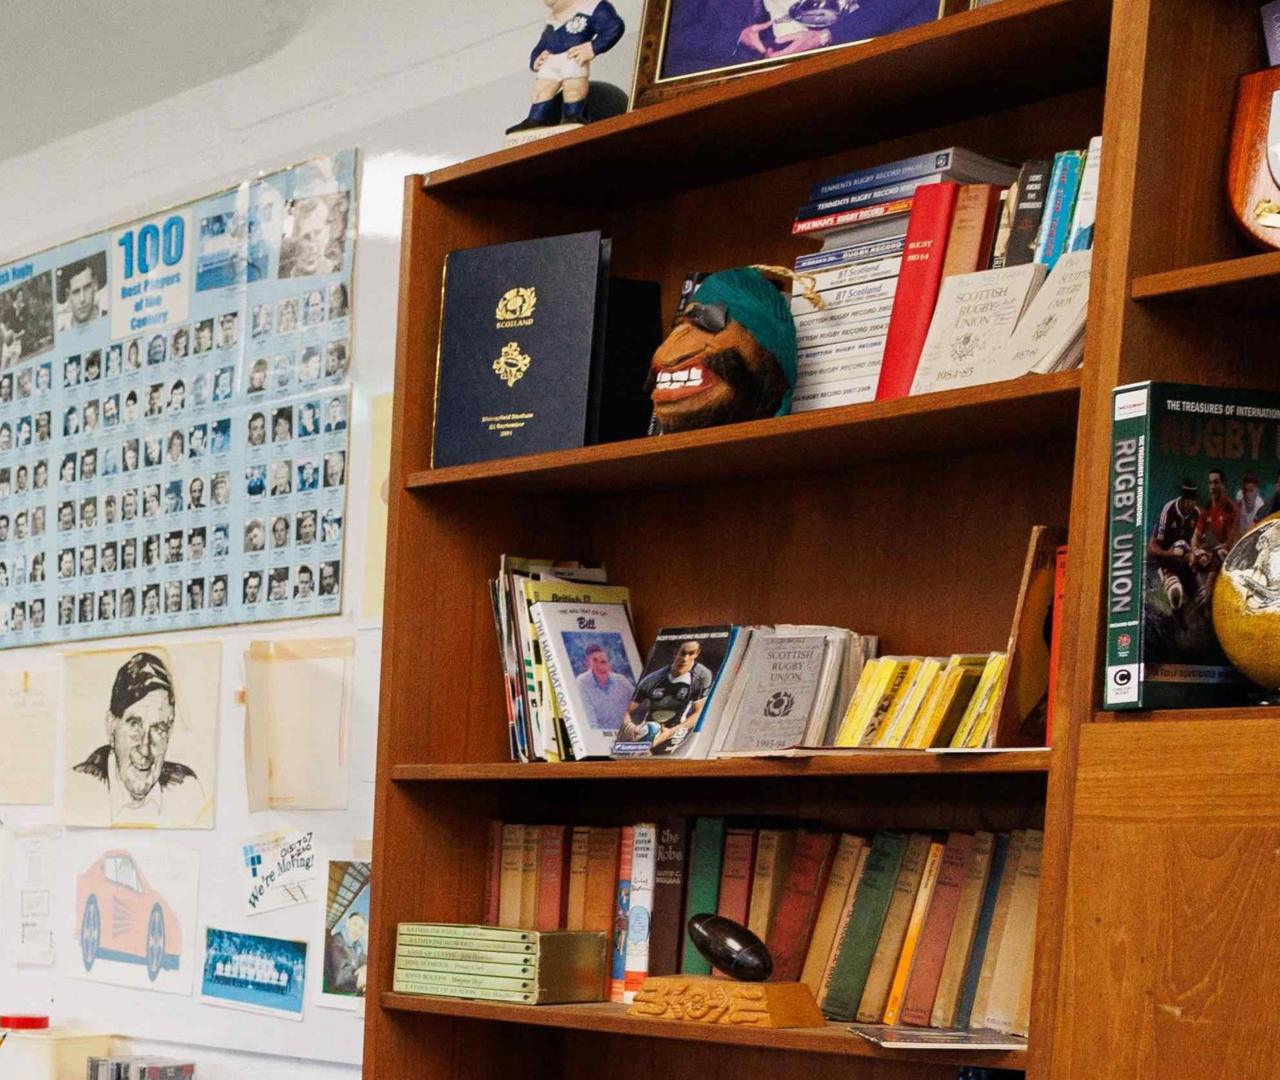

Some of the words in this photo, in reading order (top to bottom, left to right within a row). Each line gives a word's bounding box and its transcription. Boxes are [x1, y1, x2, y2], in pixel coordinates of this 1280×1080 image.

[818, 196, 850, 209] TENNENTS
[851, 192, 872, 203] RUGBY
[874, 187, 899, 198] RECORD
[118, 214, 185, 279] 100
[843, 247, 868, 258] RUGBY
[849, 285, 882, 297] Scotland
[956, 287, 1009, 303] SCOTTISH
[1167, 400, 1180, 411] THE
[1182, 402, 1224, 414] TREASURES
[1225, 405, 1235, 415] OF
[1162, 420, 1265, 460] RUGBY
[1114, 439, 1137, 523] RUGBY
[1111, 534, 1133, 613] UNION
[576, 616, 596, 630] Bill
[767, 651, 814, 659] SCOTTISH
[771, 662, 804, 671] RUGBY
[770, 673, 801, 681] UNION
[661, 829, 679, 843] the
[657, 847, 682, 861] Robe
[248, 870, 275, 909] We're
[277, 855, 315, 876] Moving!
